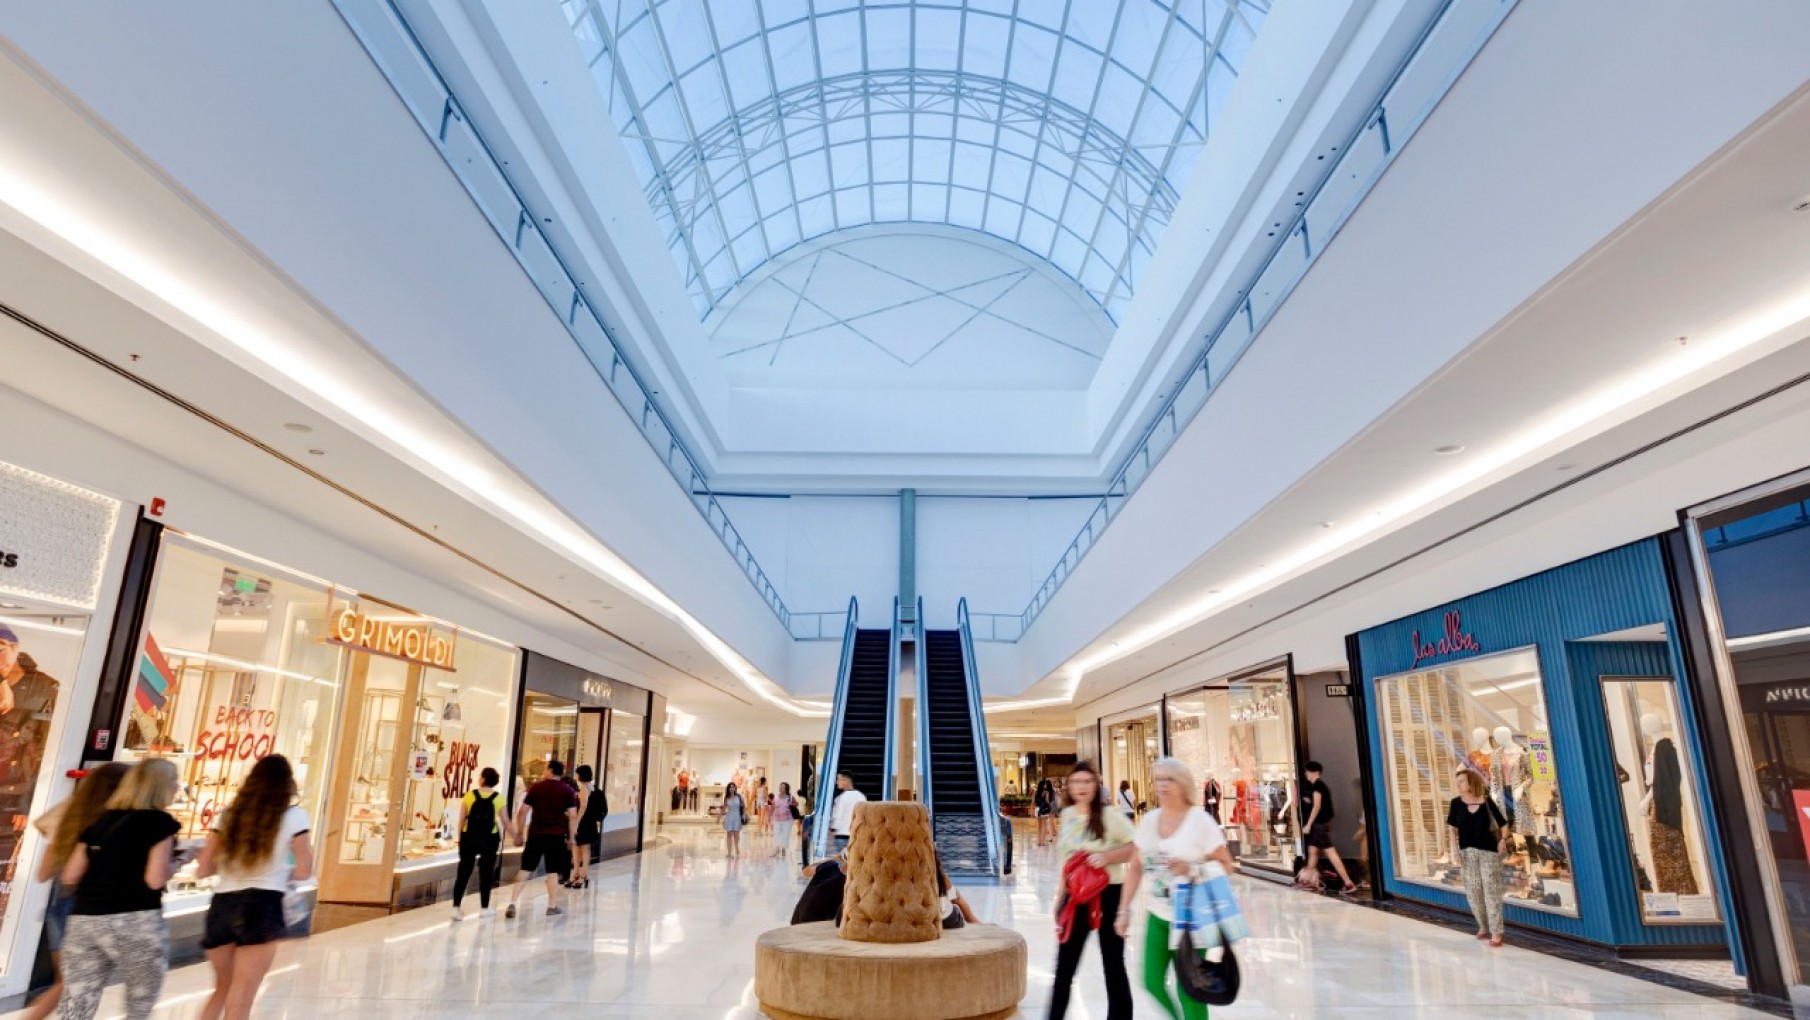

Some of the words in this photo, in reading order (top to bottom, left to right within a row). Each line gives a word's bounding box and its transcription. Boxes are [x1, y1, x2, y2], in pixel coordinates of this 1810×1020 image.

[338, 609, 454, 667] GRIMOLDI
[215, 705, 253, 728] BACK
[258, 709, 275, 728] TO
[450, 741, 480, 771] BLACK
